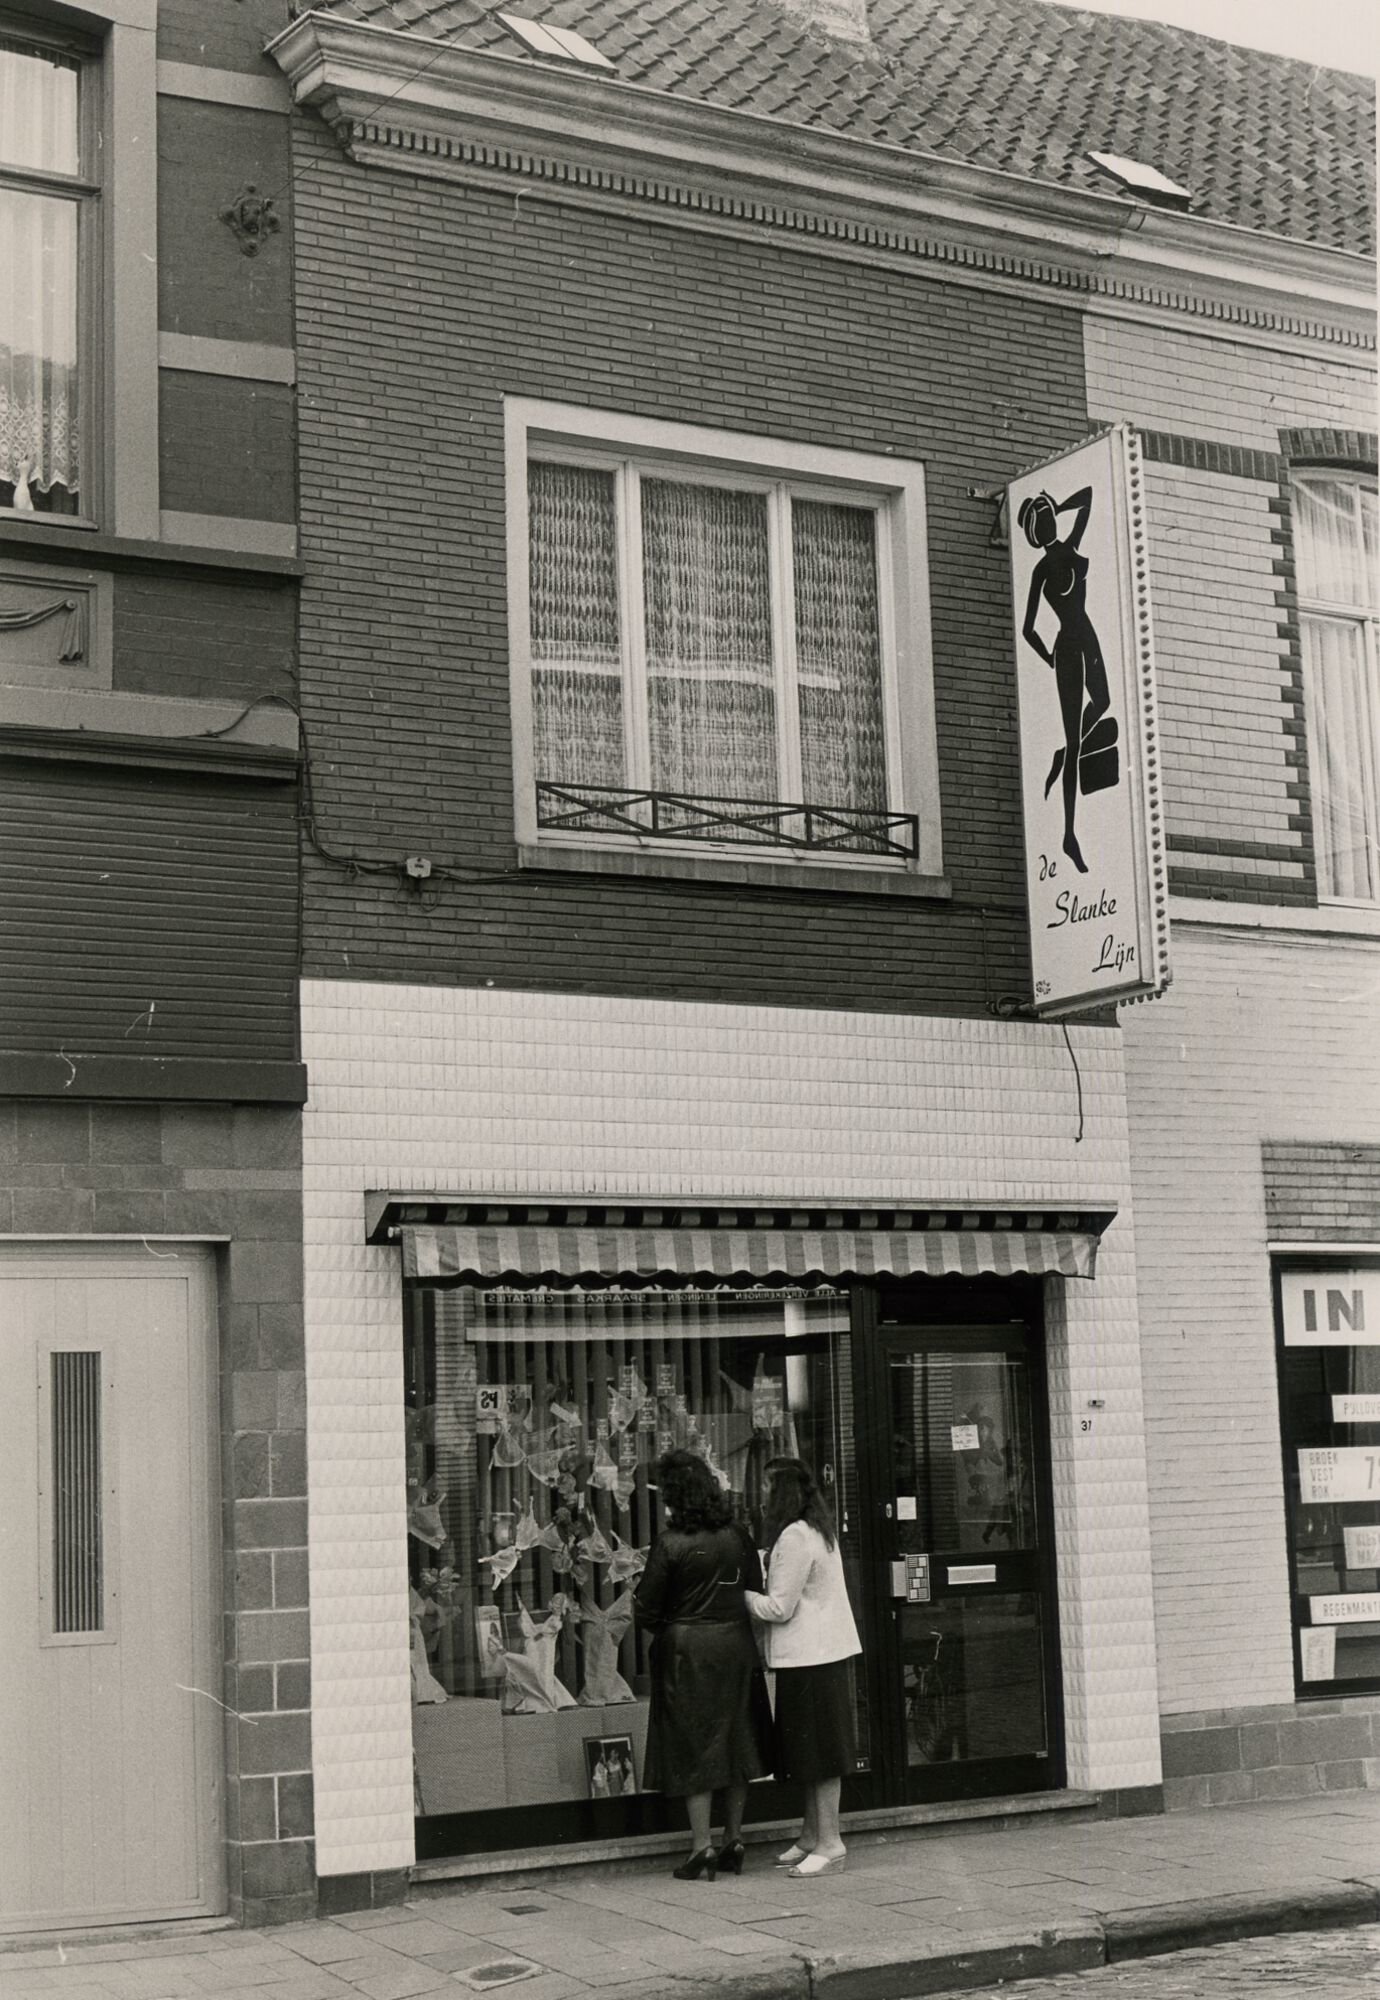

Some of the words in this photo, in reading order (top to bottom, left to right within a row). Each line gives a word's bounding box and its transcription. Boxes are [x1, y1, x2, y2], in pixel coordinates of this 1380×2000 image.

[1038, 854, 1057, 881] de
[1047, 888, 1117, 928] Slanke
[1091, 934, 1135, 973] Lijn
[1303, 1289, 1366, 1332] IN
[1080, 1419, 1092, 1431] 31
[1364, 1455, 1380, 1490] 7
[1322, 1601, 1380, 1617] REGENMANT
